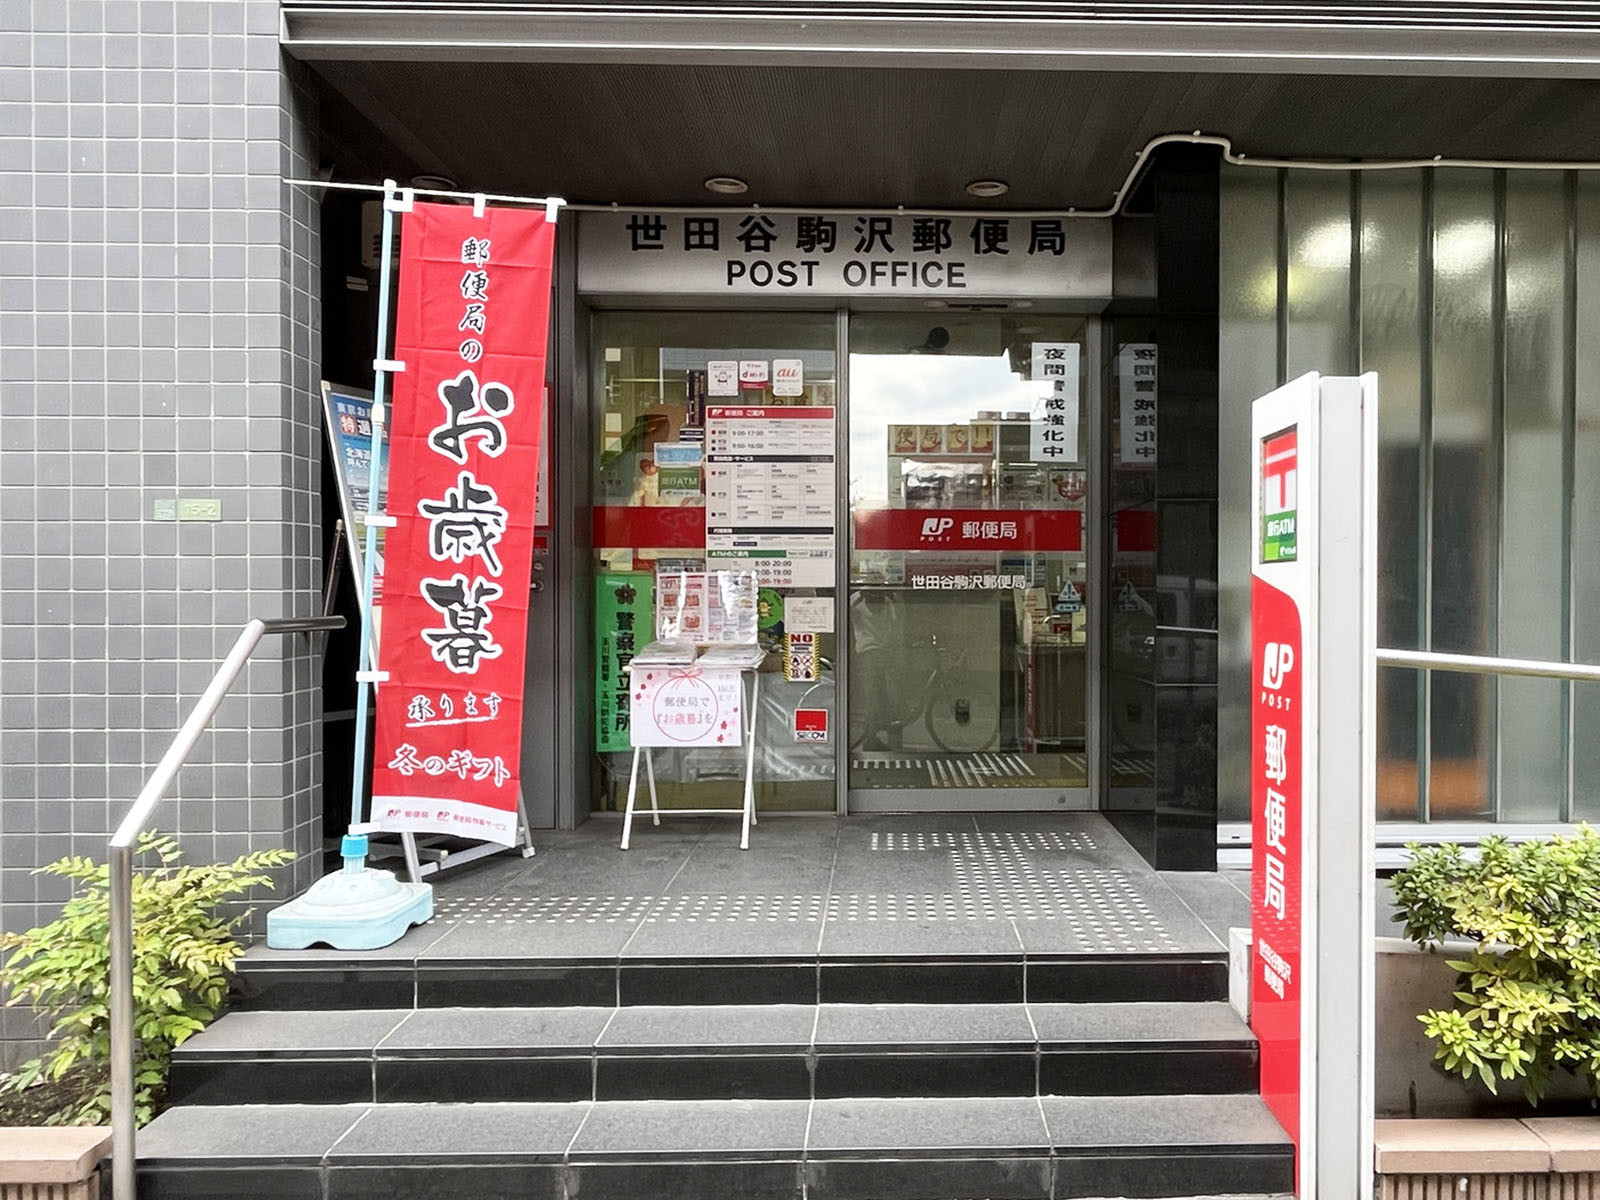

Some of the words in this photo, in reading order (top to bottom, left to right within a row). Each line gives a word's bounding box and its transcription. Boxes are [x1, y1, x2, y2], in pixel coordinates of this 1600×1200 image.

[626, 215, 1067, 255] 世田谷駒沢郵便局
[727, 260, 820, 287] POST
[842, 260, 967, 289] OFFICE
[459, 236, 490, 363] 郵便局の
[777, 368, 798, 378] au
[418, 369, 515, 675] お歳暮
[962, 521, 1018, 540] 郵便局
[911, 575, 1026, 590] 世田谷駒沢郵便局
[790, 634, 813, 642] NO
[407, 691, 502, 721] 承ります
[1261, 692, 1291, 711] POST
[388, 744, 511, 787] 冬のギフト
[1263, 724, 1287, 921] 郵便局
